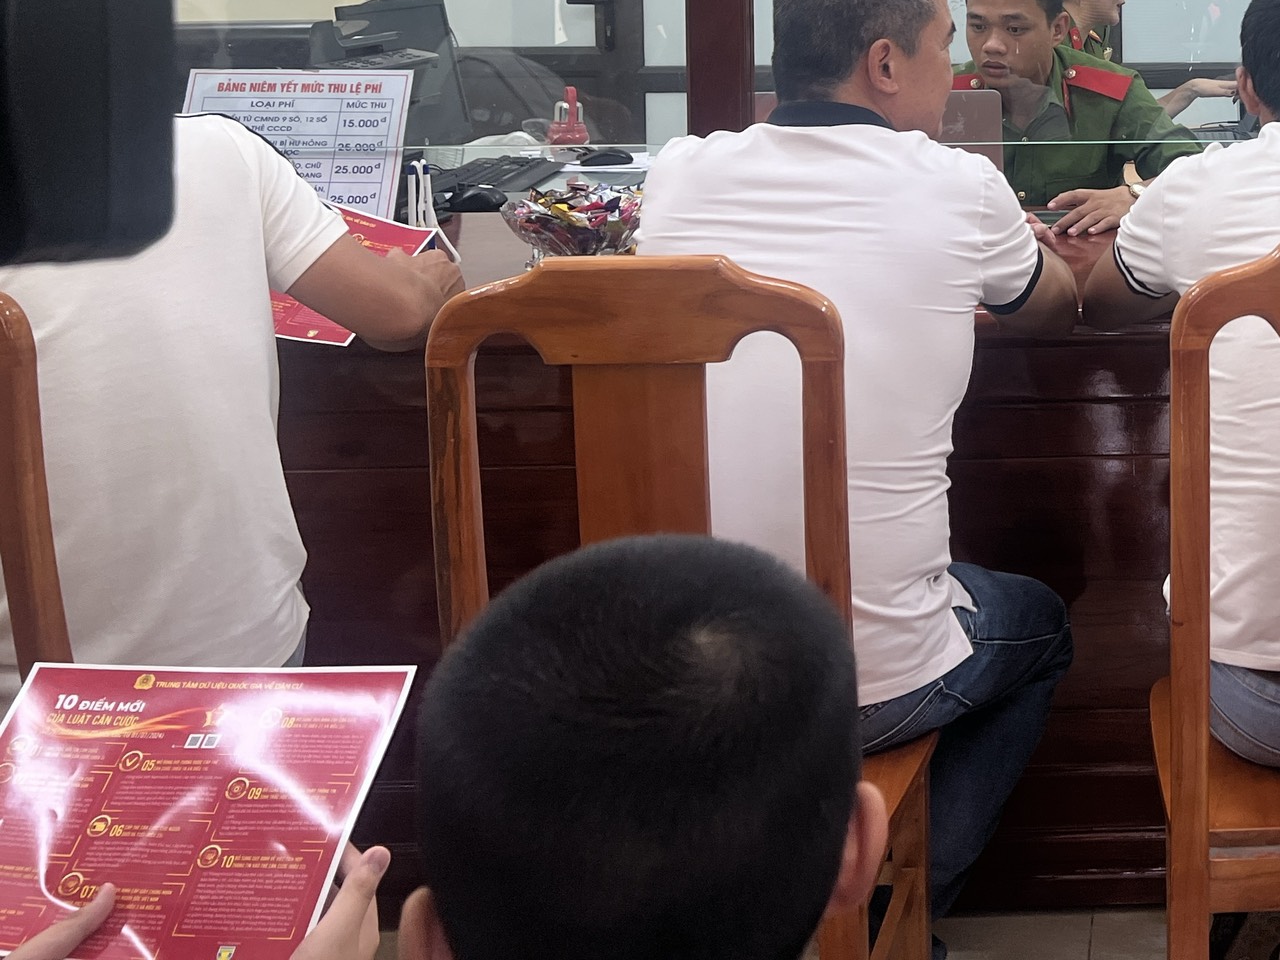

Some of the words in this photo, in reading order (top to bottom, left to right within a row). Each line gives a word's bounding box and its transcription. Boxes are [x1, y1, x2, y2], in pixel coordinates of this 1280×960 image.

[217, 79, 247, 92] BẢNG
[249, 81, 276, 92] NIÊM
[280, 80, 298, 93] YẾT
[300, 80, 324, 93] MỨC
[328, 84, 346, 93] THU
[350, 82, 362, 95] LỆ
[364, 82, 382, 93] PHÍ
[250, 101, 276, 110] LOẠI
[278, 100, 295, 108] PHÍ
[346, 100, 368, 109] MỨC
[54, 694, 78, 710] 10
[78, 698, 116, 712] ĐIỂM
[116, 699, 146, 712] MỚI
[46, 711, 65, 724] CỦA
[67, 713, 91, 726] LUẬT
[281, 717, 295, 728] 08
[141, 759, 156, 771] 05
[247, 787, 262, 799] 09
[109, 824, 124, 837] 06
[221, 855, 234, 868] 10
[80, 885, 95, 898] 07
